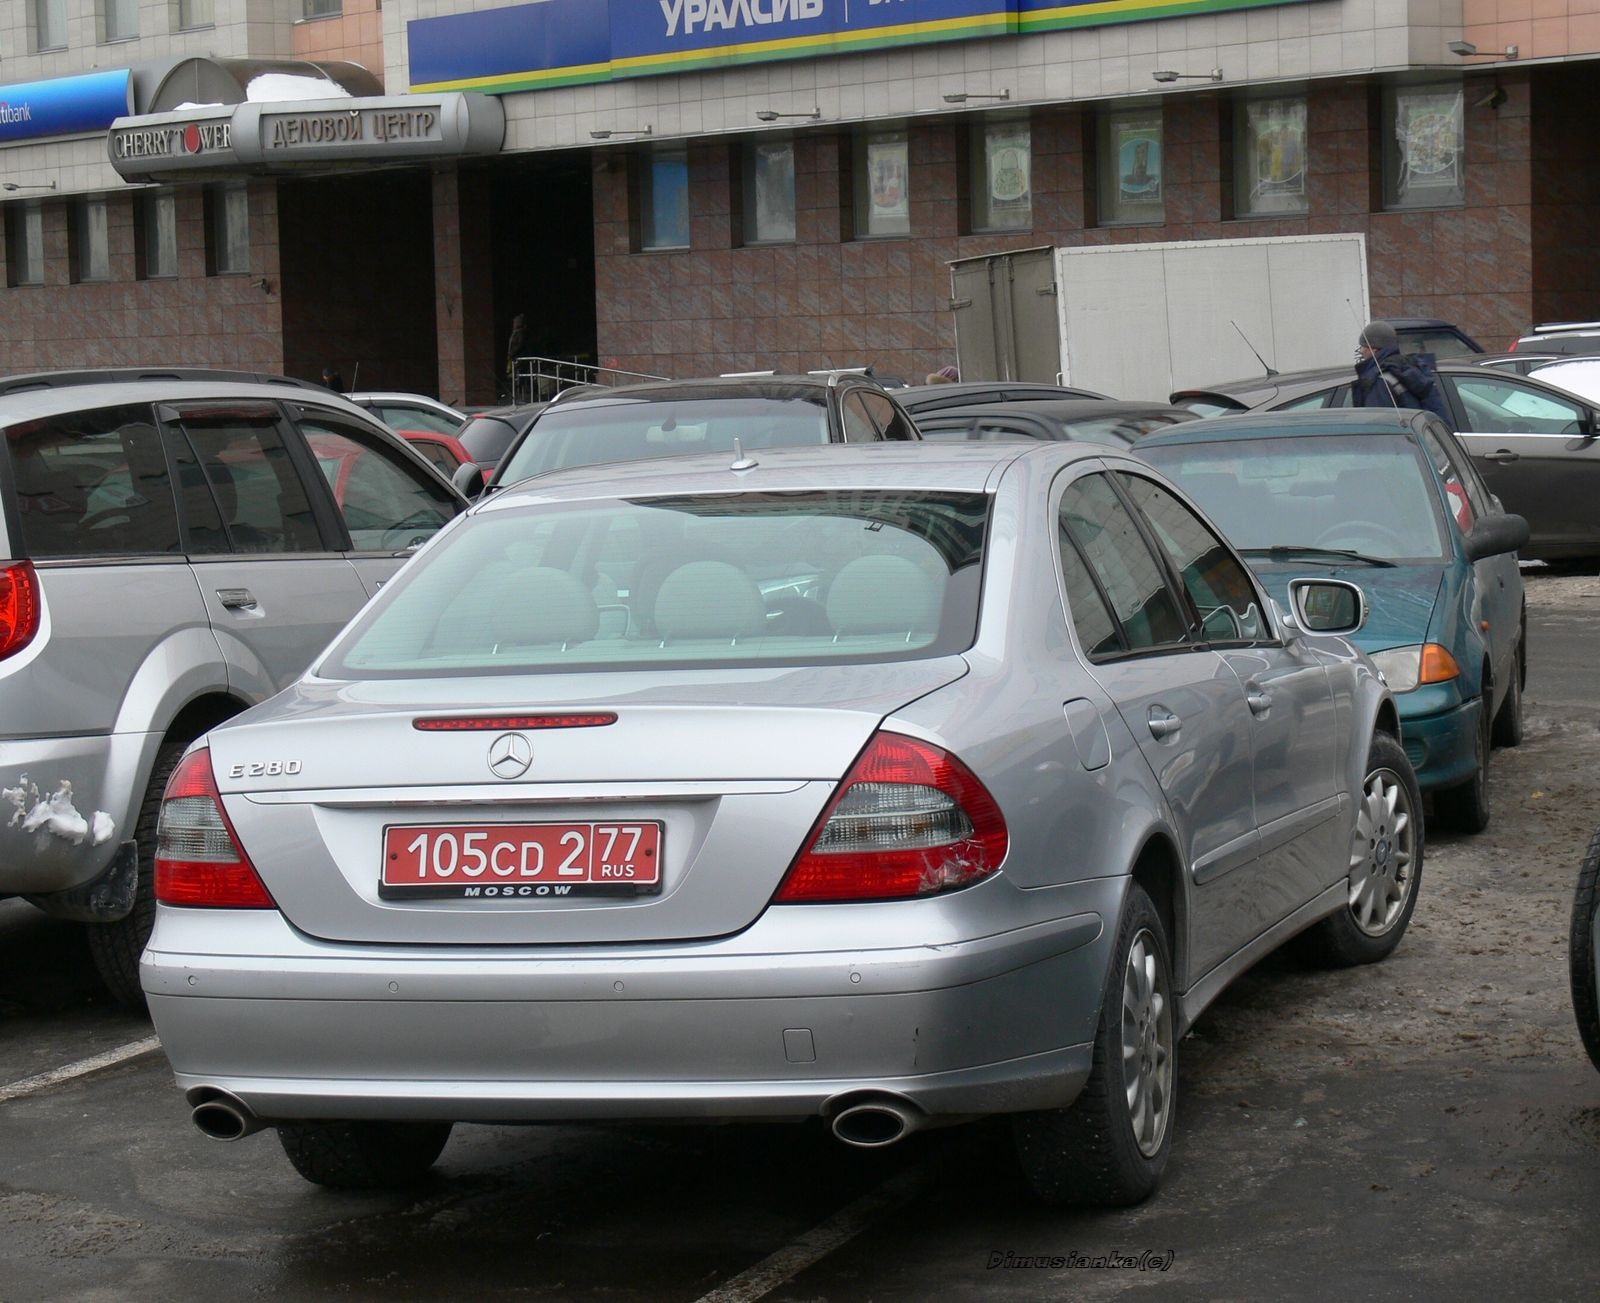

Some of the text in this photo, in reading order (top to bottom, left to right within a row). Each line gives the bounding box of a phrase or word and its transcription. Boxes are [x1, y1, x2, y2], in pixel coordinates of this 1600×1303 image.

[115, 123, 232, 157] CHERRY TOWER
[273, 111, 434, 148] ДЕЛОВОЙ ЦЕНТР
[229, 760, 302, 778] E 280
[598, 827, 642, 861] 77
[601, 864, 635, 877] RUS
[464, 885, 572, 897] MOSCOW
